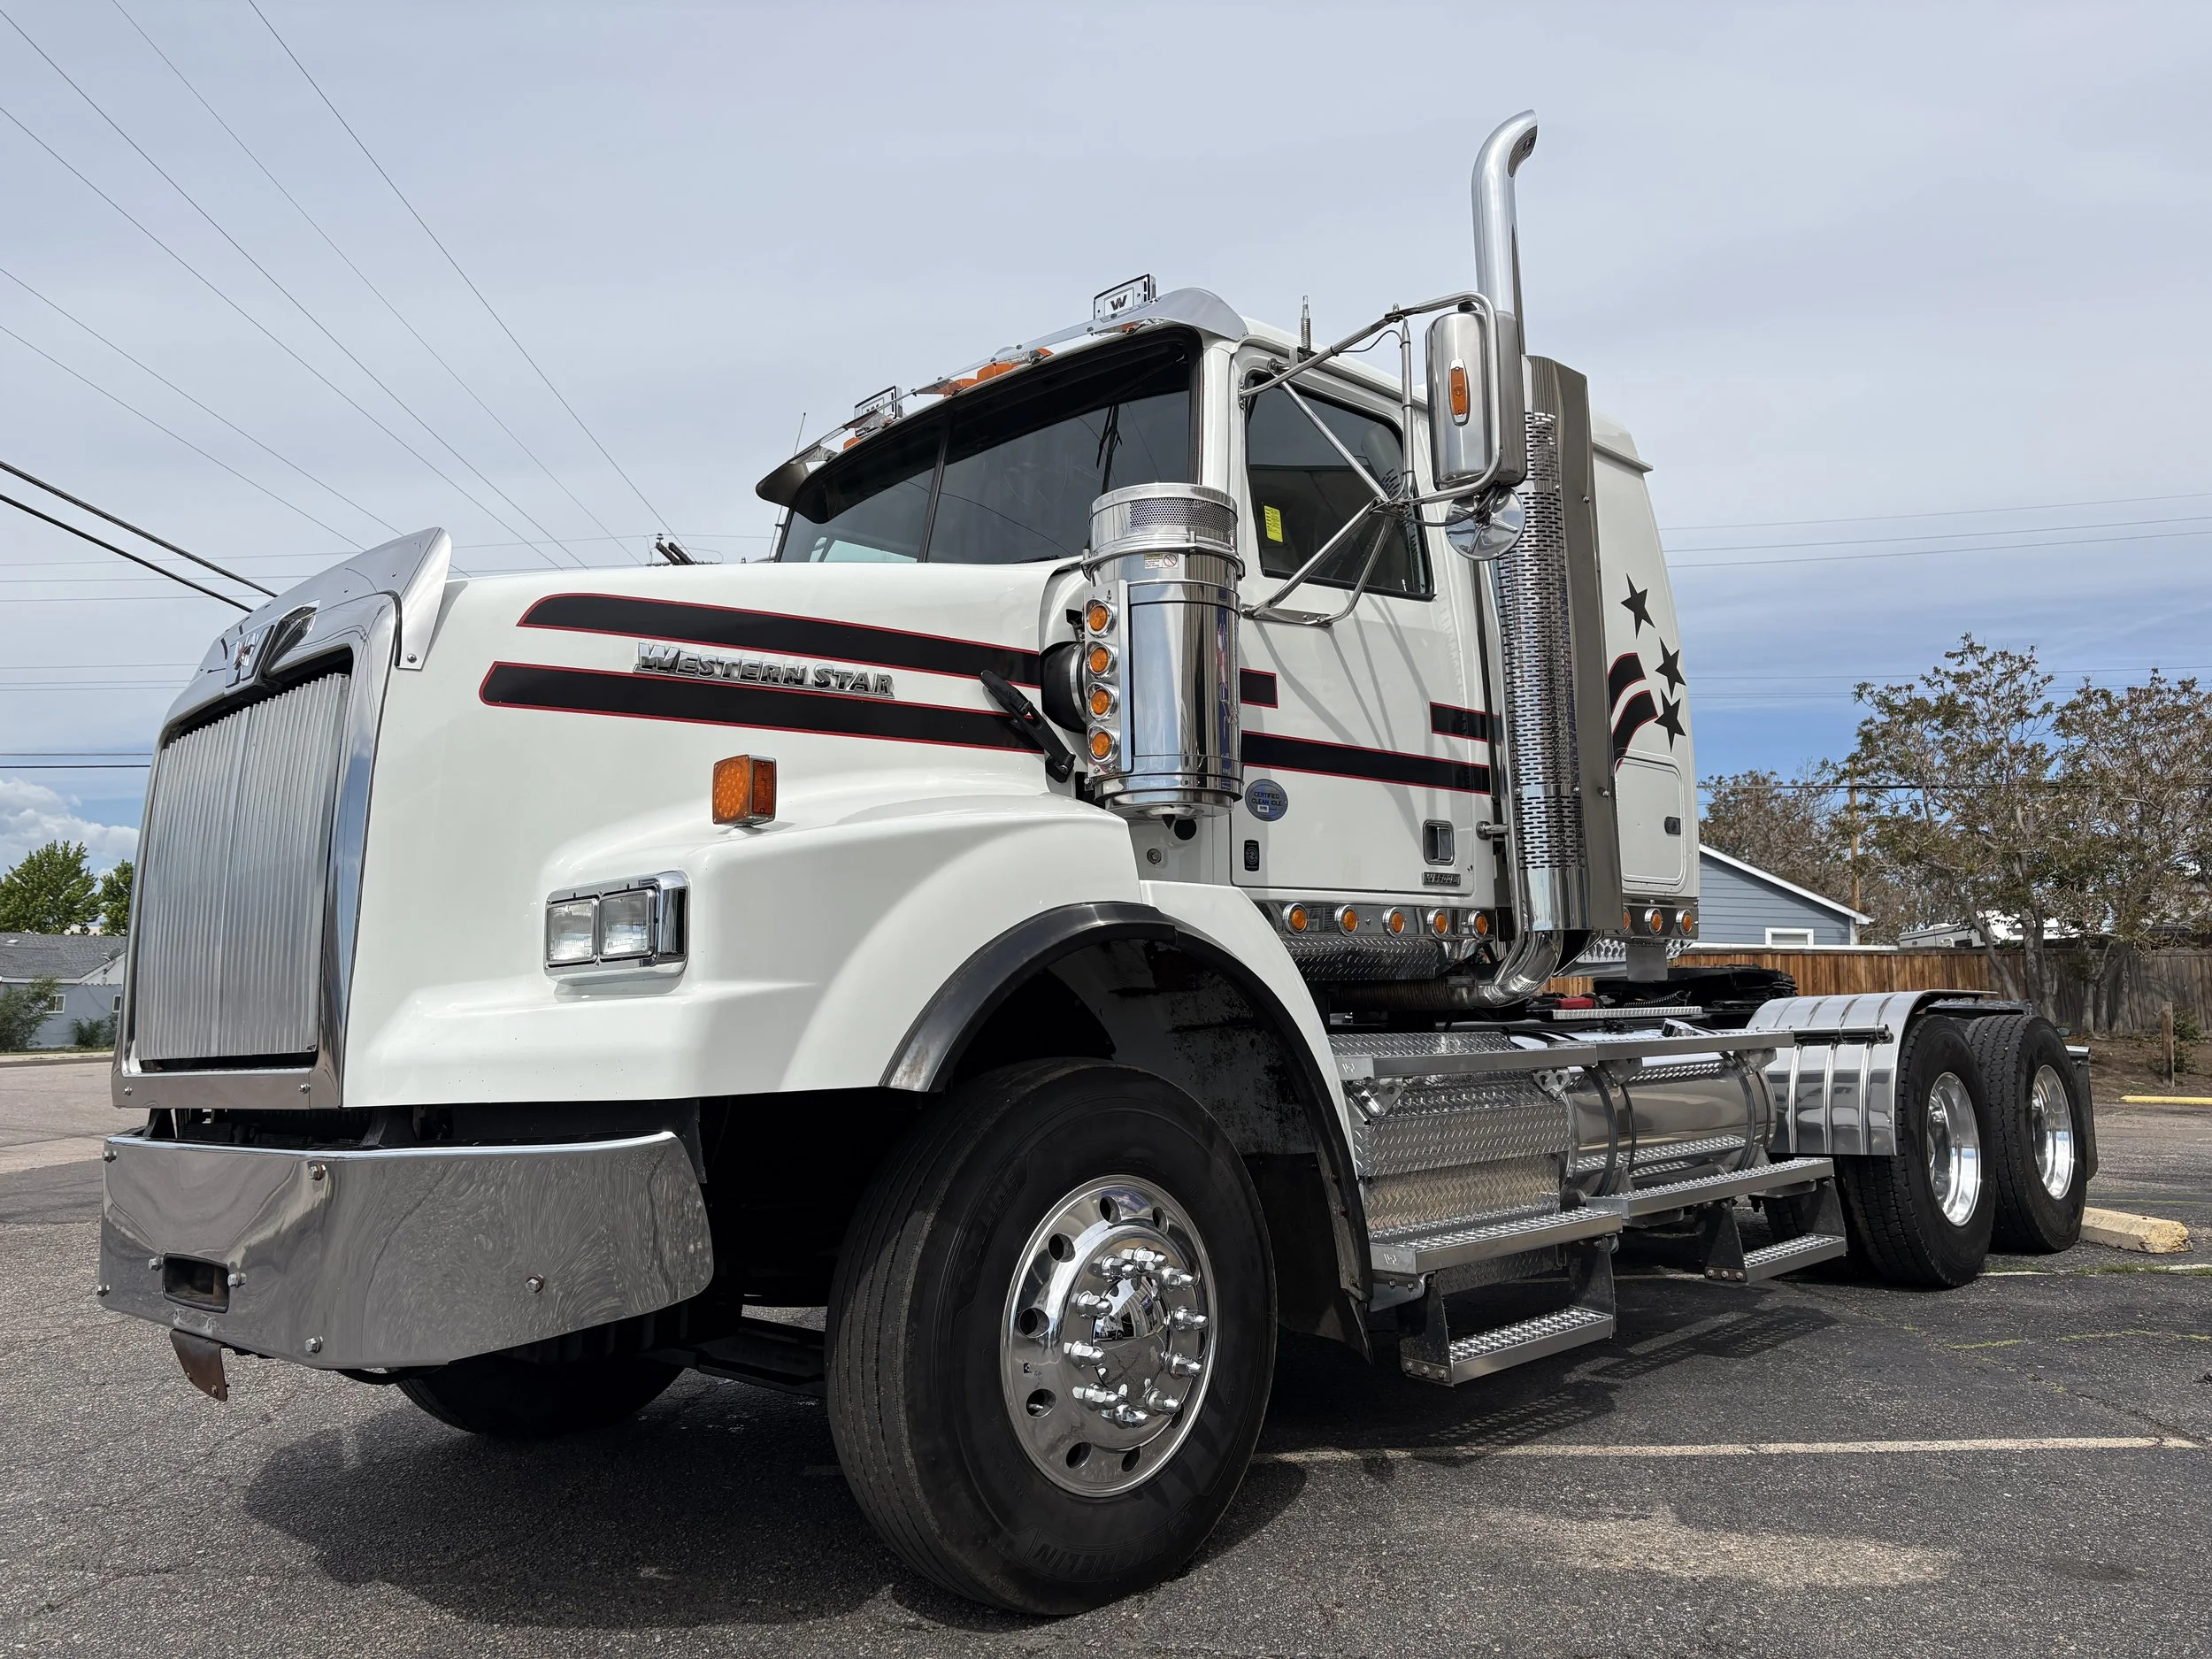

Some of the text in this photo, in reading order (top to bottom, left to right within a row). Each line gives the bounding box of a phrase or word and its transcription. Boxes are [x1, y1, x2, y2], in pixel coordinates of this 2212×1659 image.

[638, 641, 894, 695] WESTERN STAR
[1253, 791, 1280, 800] CERTIFIED
